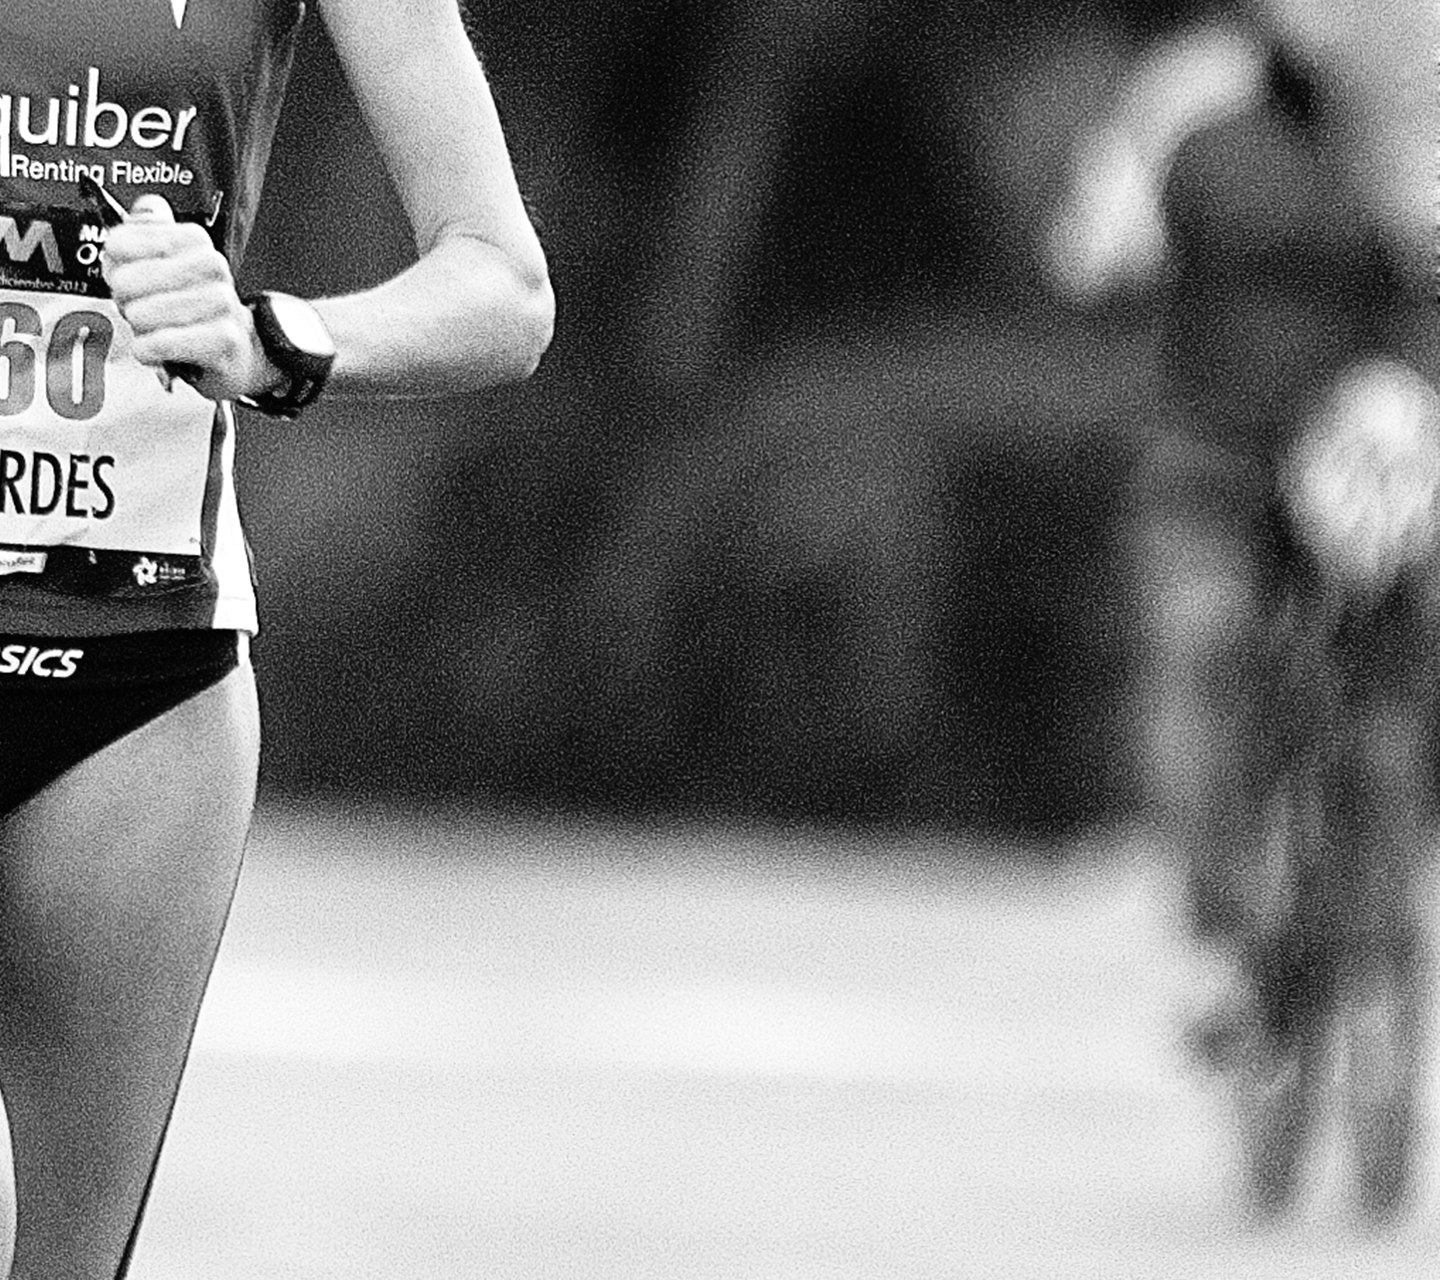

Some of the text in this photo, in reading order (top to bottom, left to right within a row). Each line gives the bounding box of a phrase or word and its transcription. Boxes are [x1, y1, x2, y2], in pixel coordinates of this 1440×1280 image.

[11, 154, 194, 187] Renting Flexible
[56, 280, 88, 294] 2013
